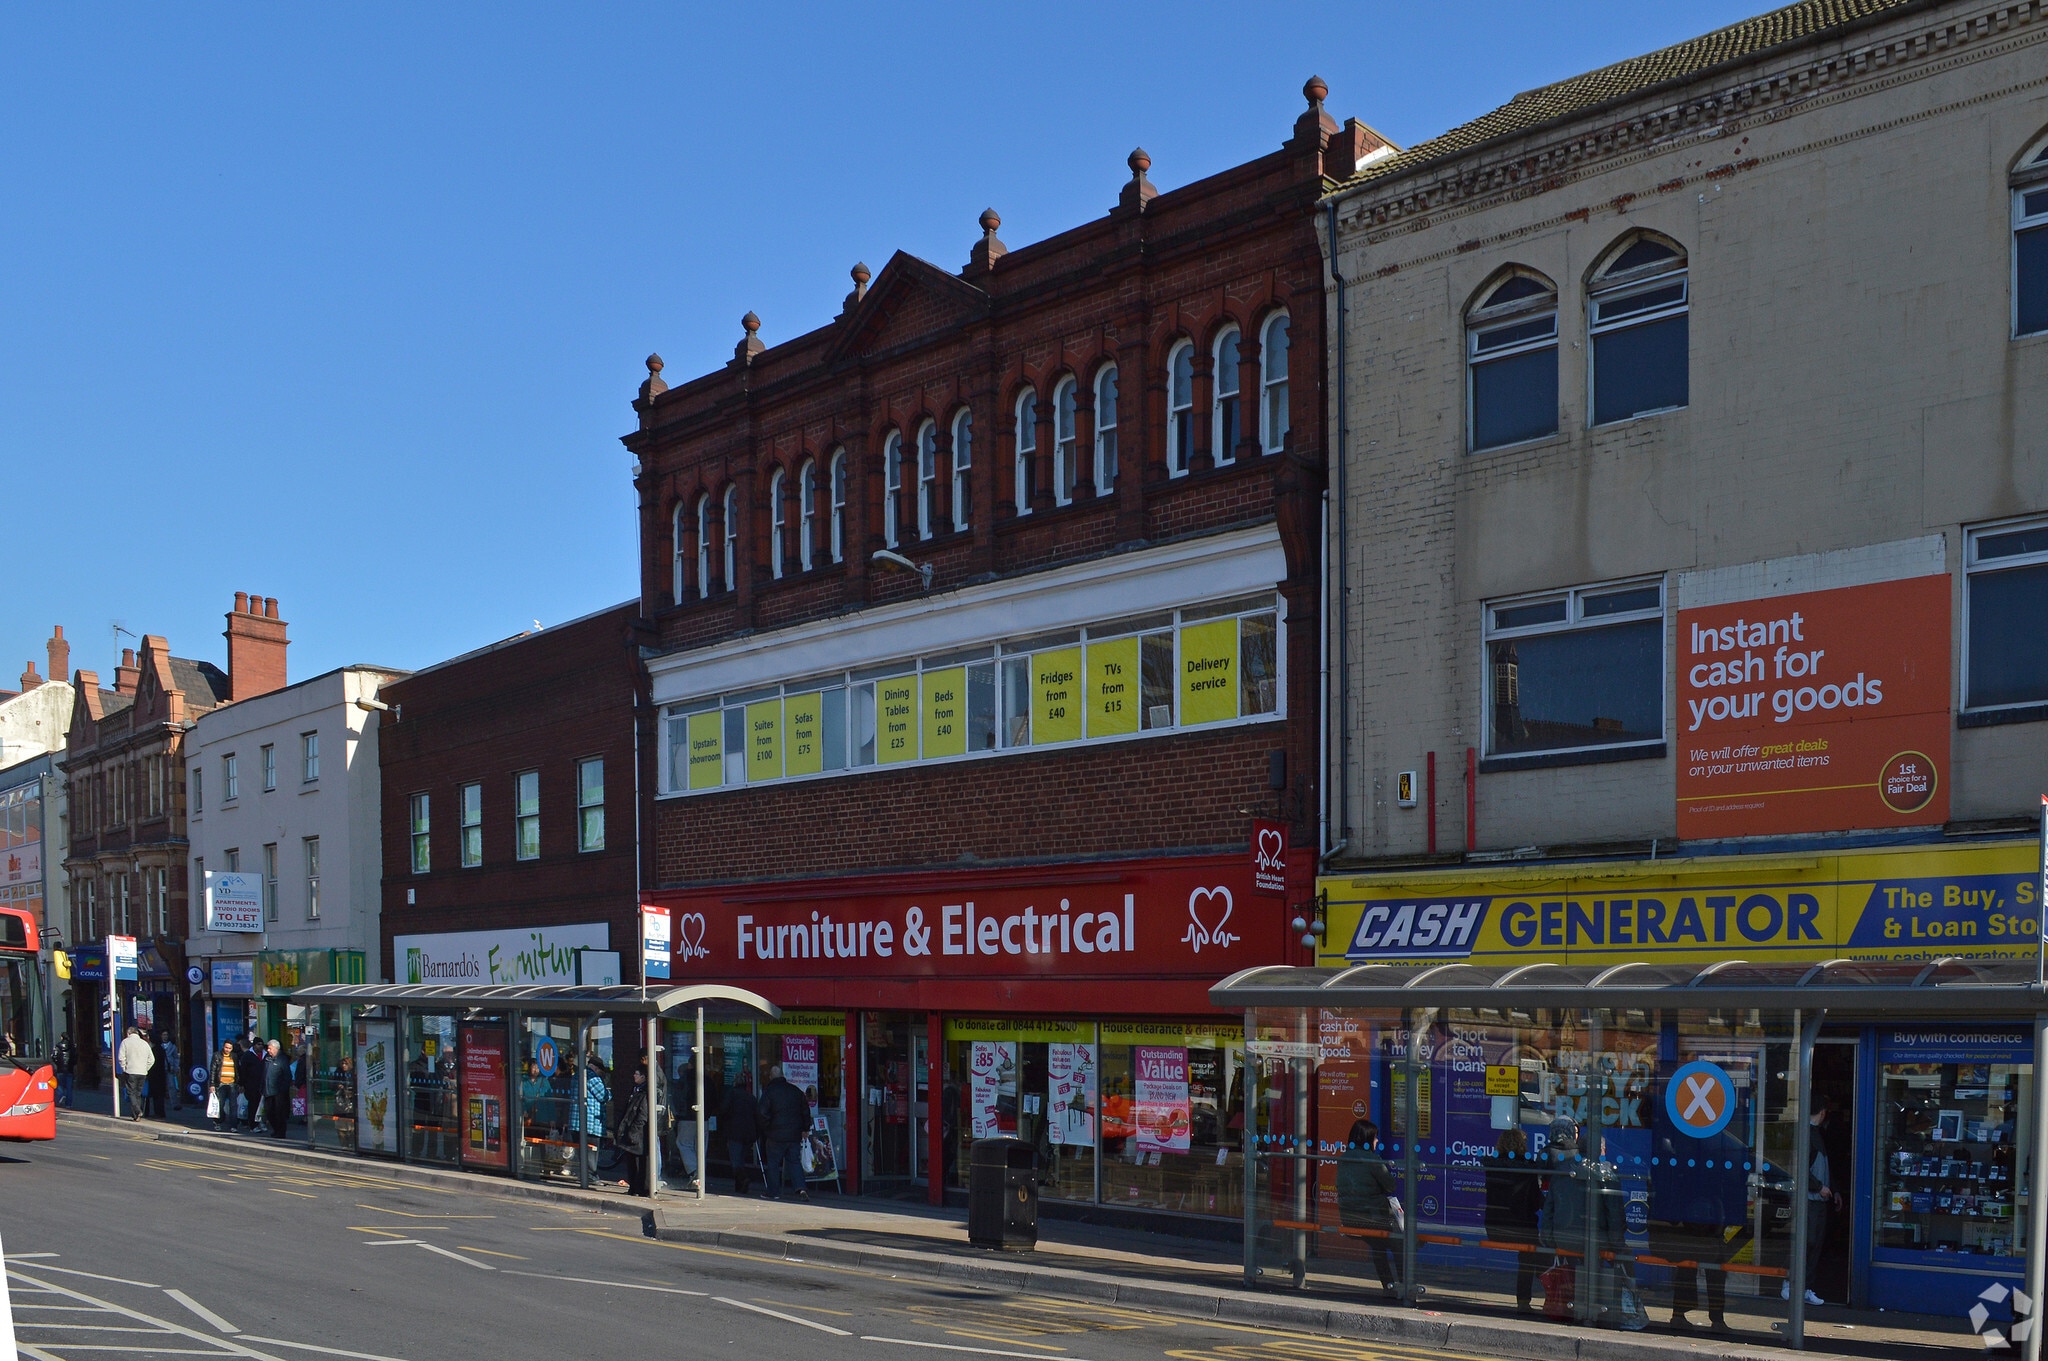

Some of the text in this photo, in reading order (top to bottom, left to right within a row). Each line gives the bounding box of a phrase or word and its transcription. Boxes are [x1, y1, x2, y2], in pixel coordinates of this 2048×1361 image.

[1691, 611, 1804, 654] Instant
[1105, 663, 1122, 676] TVs
[1187, 656, 1230, 673] Delivery
[1689, 646, 1825, 688] cash for
[1040, 671, 1073, 685] Fridges
[1190, 677, 1227, 692] service
[885, 688, 909, 700] Dining
[1102, 682, 1124, 694] from
[935, 690, 954, 702] Beds
[1046, 691, 1067, 702] from
[1688, 672, 1883, 731] your goods
[885, 704, 909, 717] Tables
[1049, 707, 1065, 719] £40
[1105, 700, 1122, 713] £15
[795, 713, 813, 724] Sofas
[935, 709, 953, 719] from
[754, 720, 774, 731] Suites
[888, 722, 906, 733] from
[937, 724, 952, 736] £40
[796, 729, 812, 739] from
[693, 738, 717, 751] Upstairs
[756, 736, 772, 746] from
[891, 738, 904, 748] £25
[757, 750, 773, 761] £100
[798, 744, 811, 755] £75
[1690, 738, 1828, 762] We will offer great deals
[690, 753, 721, 765] showroom
[1689, 754, 1830, 778] on your unwanted items
[1899, 764, 1916, 775] 1st
[1888, 775, 1910, 784] choice
[1911, 775, 1921, 783] for
[1887, 782, 1927, 795] Fair Deal
[1256, 872, 1284, 882] British Heart
[1256, 880, 1284, 891] Foundation
[1883, 887, 1933, 909] The
[1944, 885, 2005, 911] Buy,
[218, 913, 233, 921] TO
[1500, 894, 1823, 947] GENERATOR
[737, 893, 1134, 960] Furniture & Electrical
[1355, 903, 1483, 948] CASH
[1884, 913, 2038, 938] & Loan Sto
[422, 953, 480, 978] Barnardo's
[488, 933, 590, 985] Furnitur
[799, 1015, 829, 1026] Electrical
[953, 1020, 963, 1030] To
[966, 1019, 995, 1031] donate
[996, 1019, 1011, 1031] call
[1013, 1020, 1034, 1031] 0844
[1036, 1021, 1053, 1032] 412
[1320, 1021, 1359, 1033] cash for
[1103, 1022, 1133, 1033] House
[1135, 1022, 1183, 1035] clearance
[1184, 1024, 1193, 1035] &
[1195, 1023, 1239, 1040] delivery
[1453, 1027, 1488, 1041] Short
[786, 1036, 815, 1046] Outstanding
[1320, 1036, 1342, 1049] your
[1894, 1032, 2023, 1046] Buy with confidence
[786, 1046, 815, 1061] Value
[1052, 1048, 1072, 1056] Fabulous
[1141, 1049, 1183, 1061] Outstanding
[1320, 1047, 1351, 1059] goods
[1391, 1045, 1434, 1059] mey
[1453, 1044, 1483, 1057] term
[540, 1048, 554, 1067] W
[976, 1053, 994, 1067] £85
[1141, 1060, 1184, 1080] Value
[1453, 1058, 1487, 1072] loans
[1683, 1076, 1716, 1121] X
[1555, 1096, 1642, 1126] BACK
[1452, 1141, 1495, 1156] Chequ
